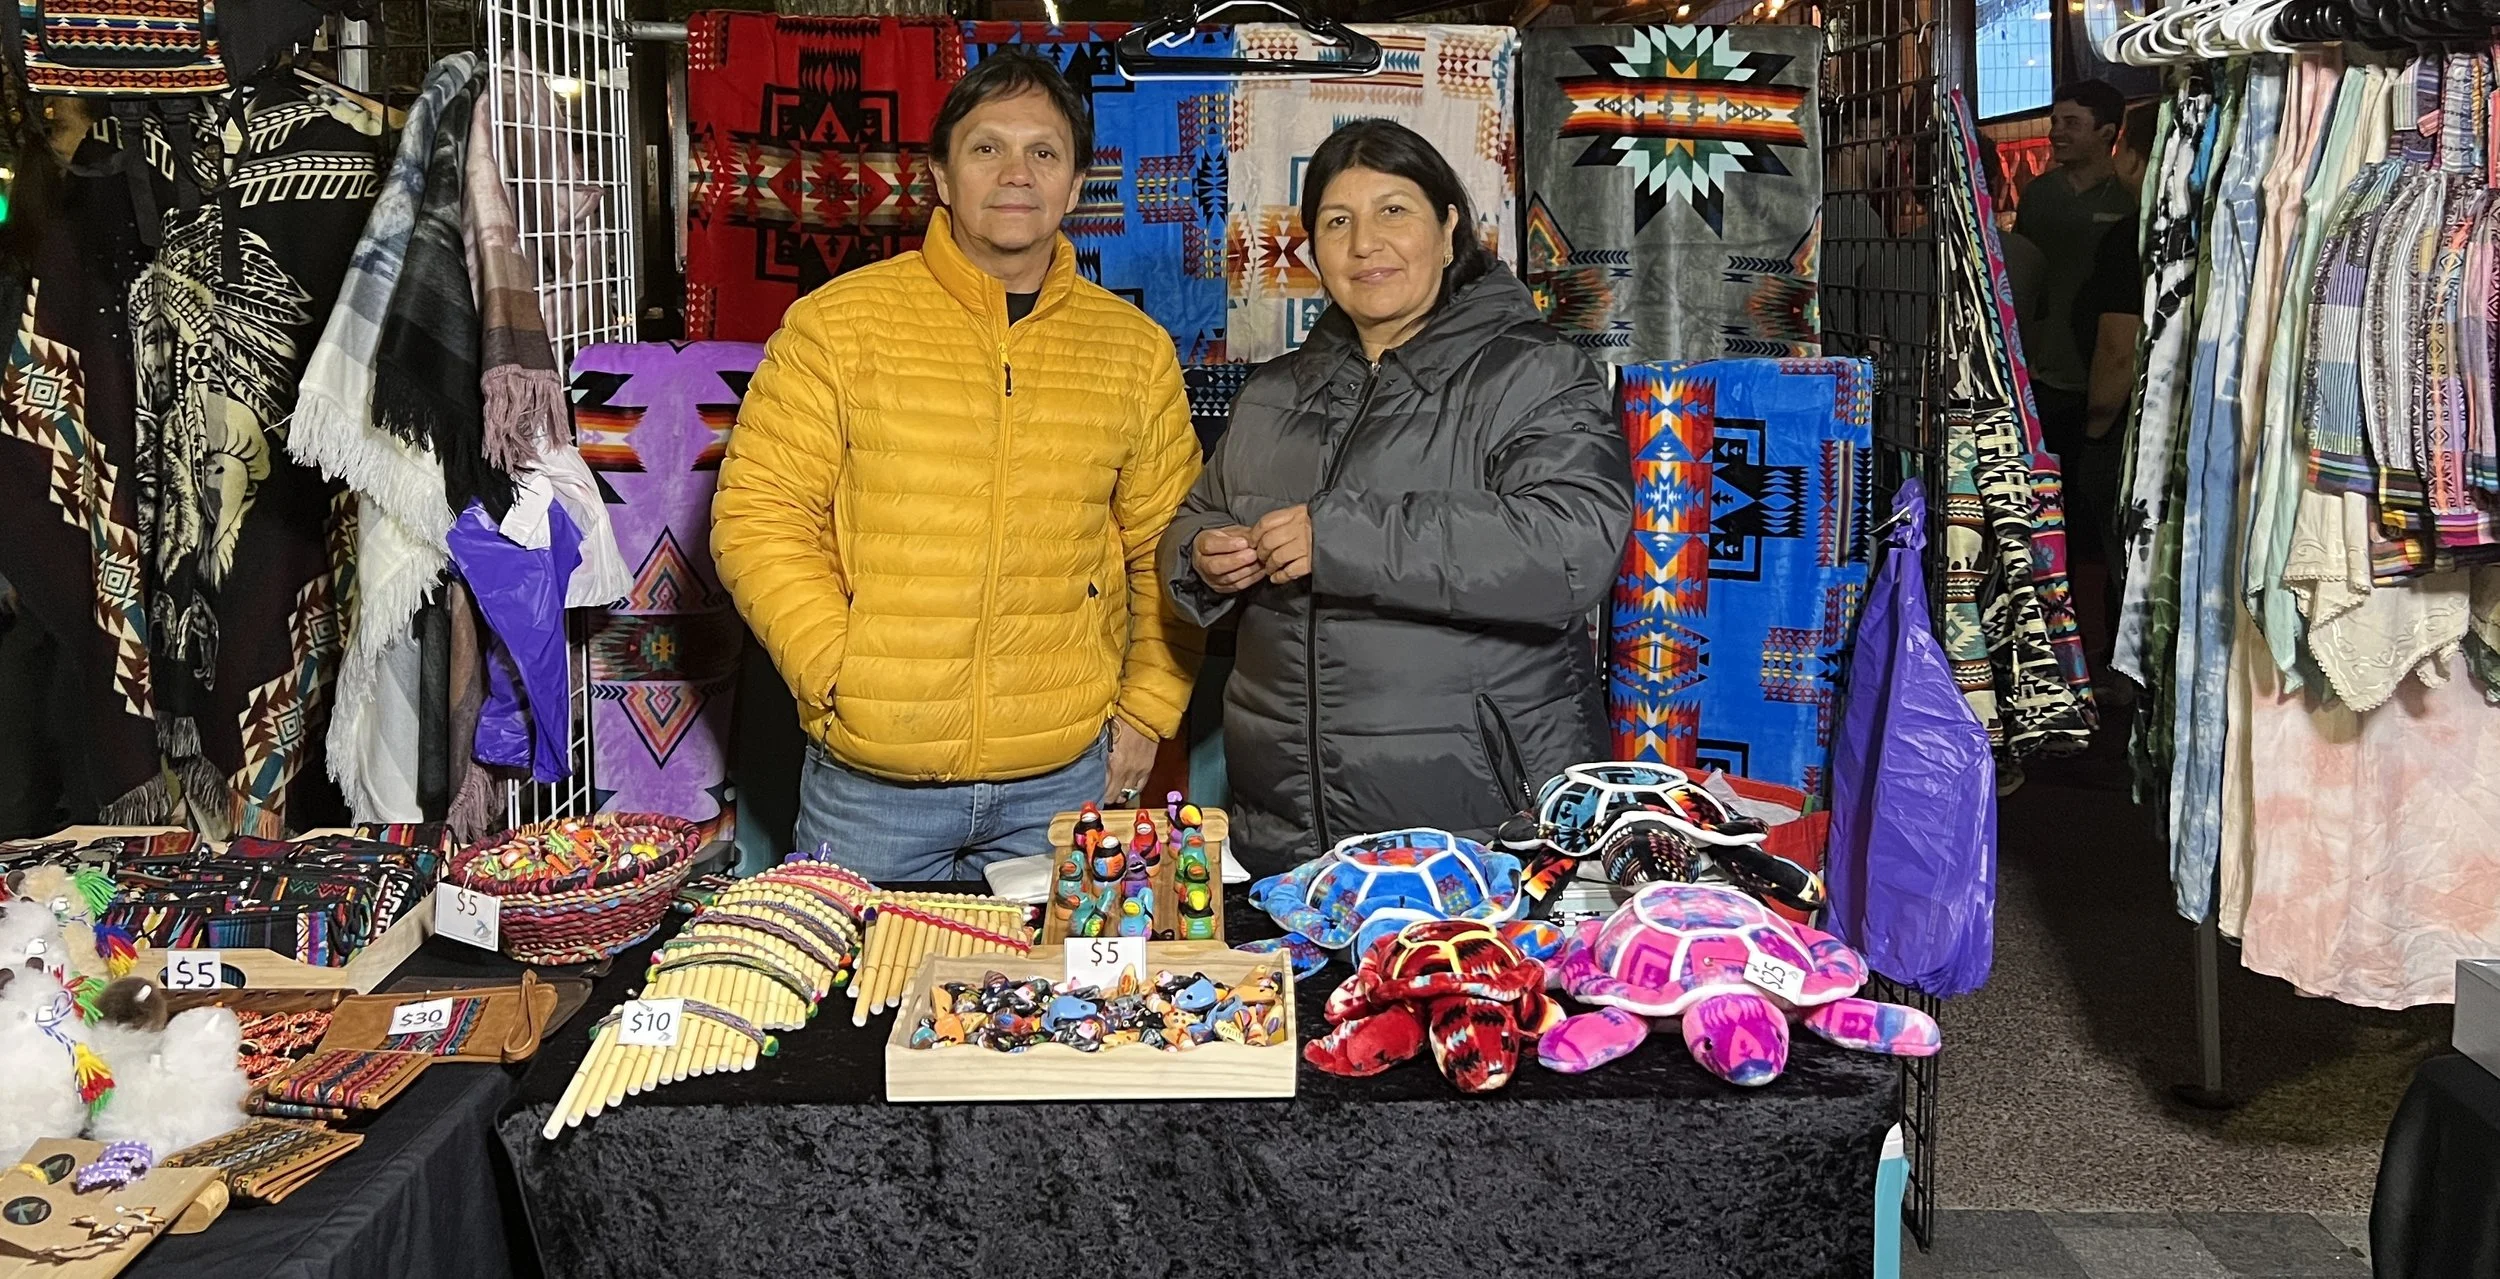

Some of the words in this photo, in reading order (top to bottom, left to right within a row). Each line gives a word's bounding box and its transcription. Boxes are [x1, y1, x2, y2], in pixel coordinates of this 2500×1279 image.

[456, 889, 477, 916] $5
[1091, 938, 1119, 967] $5
[176, 956, 215, 990] $5
[1758, 961, 1786, 990] $25
[399, 1009, 443, 1027] $30
[629, 1011, 671, 1034] $10
